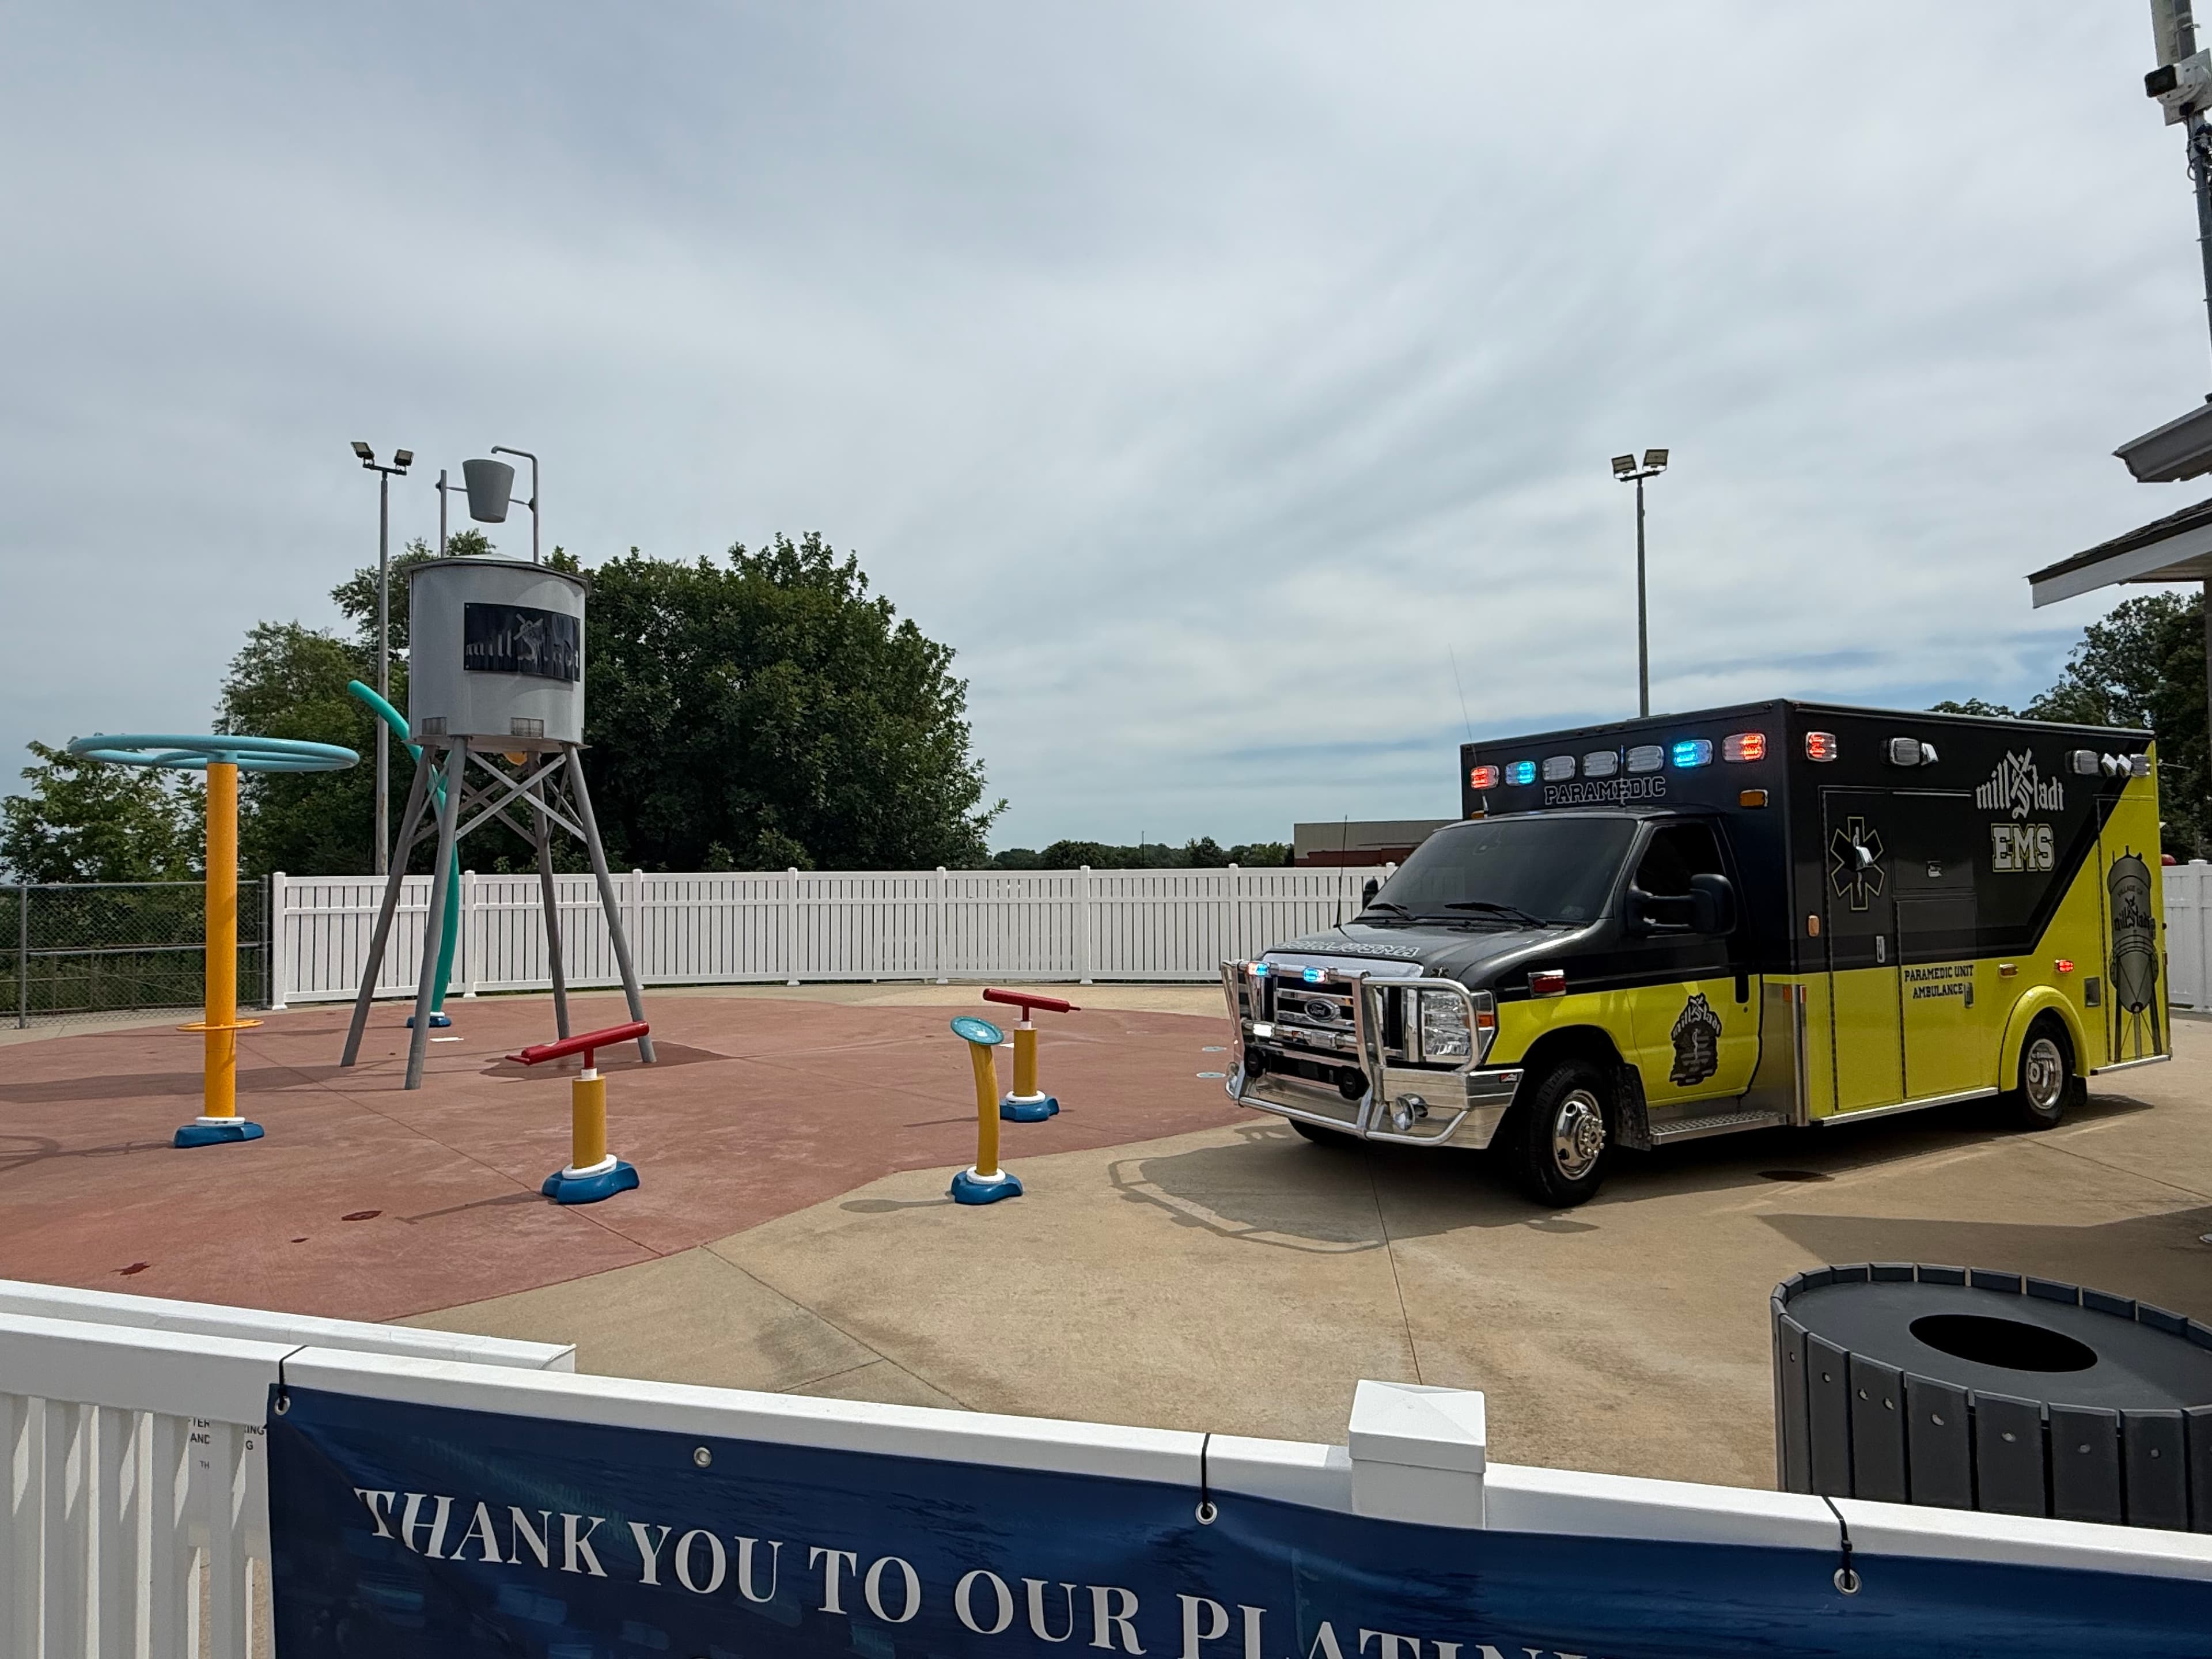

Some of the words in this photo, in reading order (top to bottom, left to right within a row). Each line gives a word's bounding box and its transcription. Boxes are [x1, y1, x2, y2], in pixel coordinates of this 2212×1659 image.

[1544, 775, 1666, 805] PARAMEDIC
[1990, 823, 2055, 873] EMS
[1904, 966, 1953, 982] PARAMEDIC
[1955, 964, 1974, 978] UNIT
[1913, 983, 1964, 999] AMBULANCE
[353, 1487, 608, 1577] THANK
[627, 1521, 783, 1604] YOU
[809, 1546, 922, 1623] TO
[954, 1569, 1147, 1656] OUR
